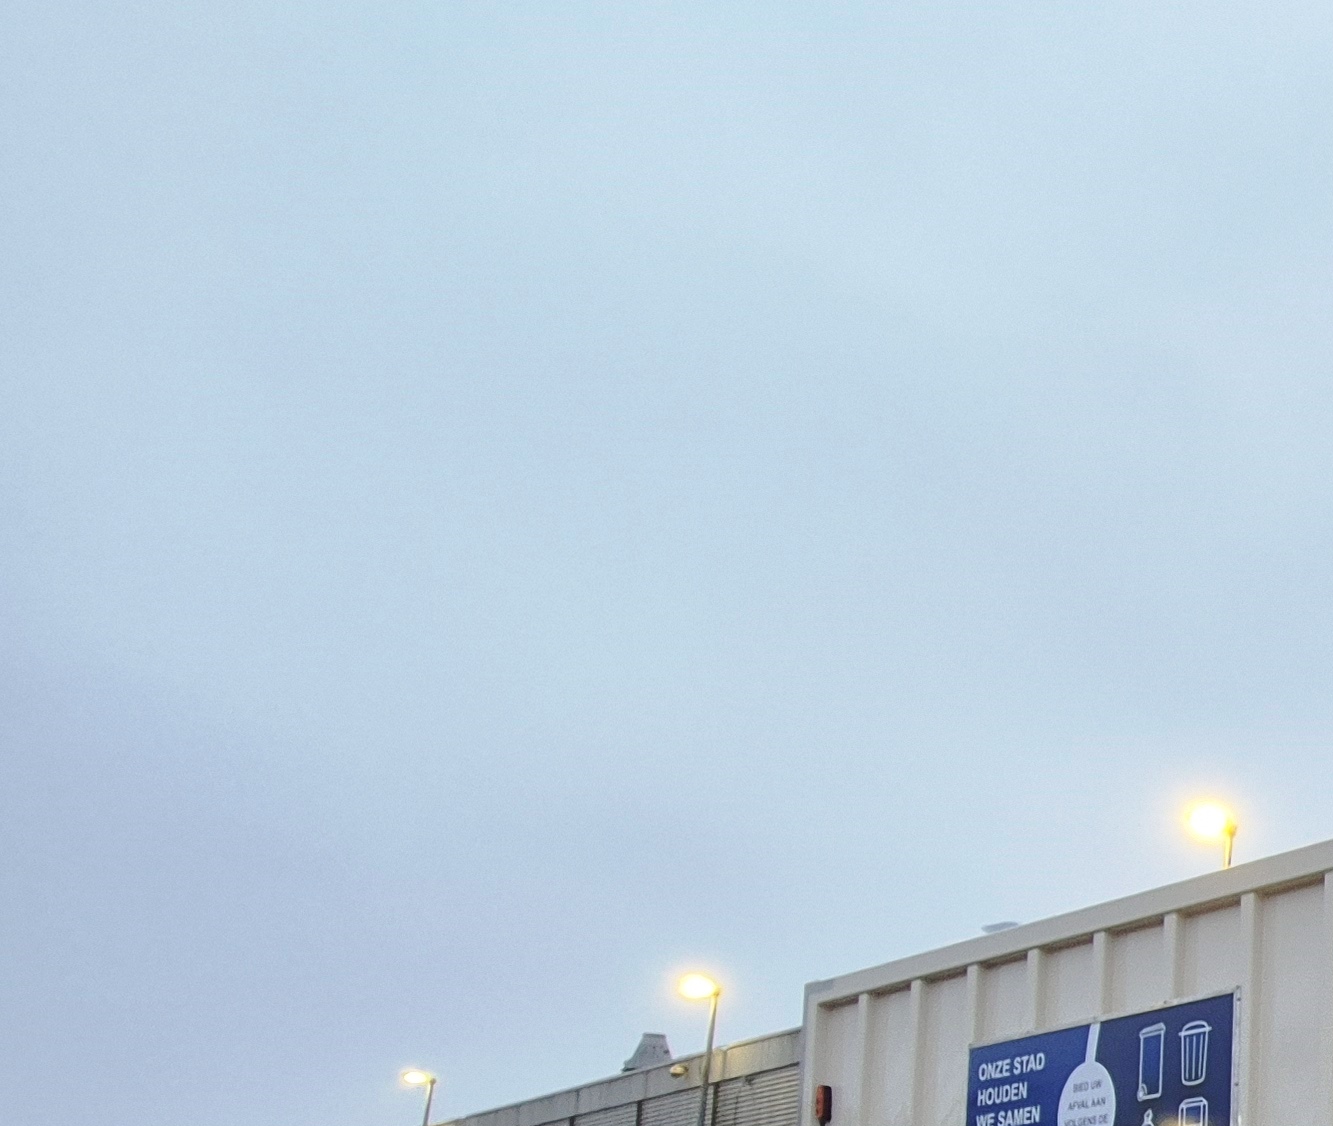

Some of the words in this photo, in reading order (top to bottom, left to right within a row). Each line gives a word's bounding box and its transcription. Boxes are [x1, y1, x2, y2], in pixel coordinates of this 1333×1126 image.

[979, 1059, 1011, 1081] ONZE
[1013, 1052, 1045, 1076] STAD
[977, 1081, 1028, 1106] HOUDEN
